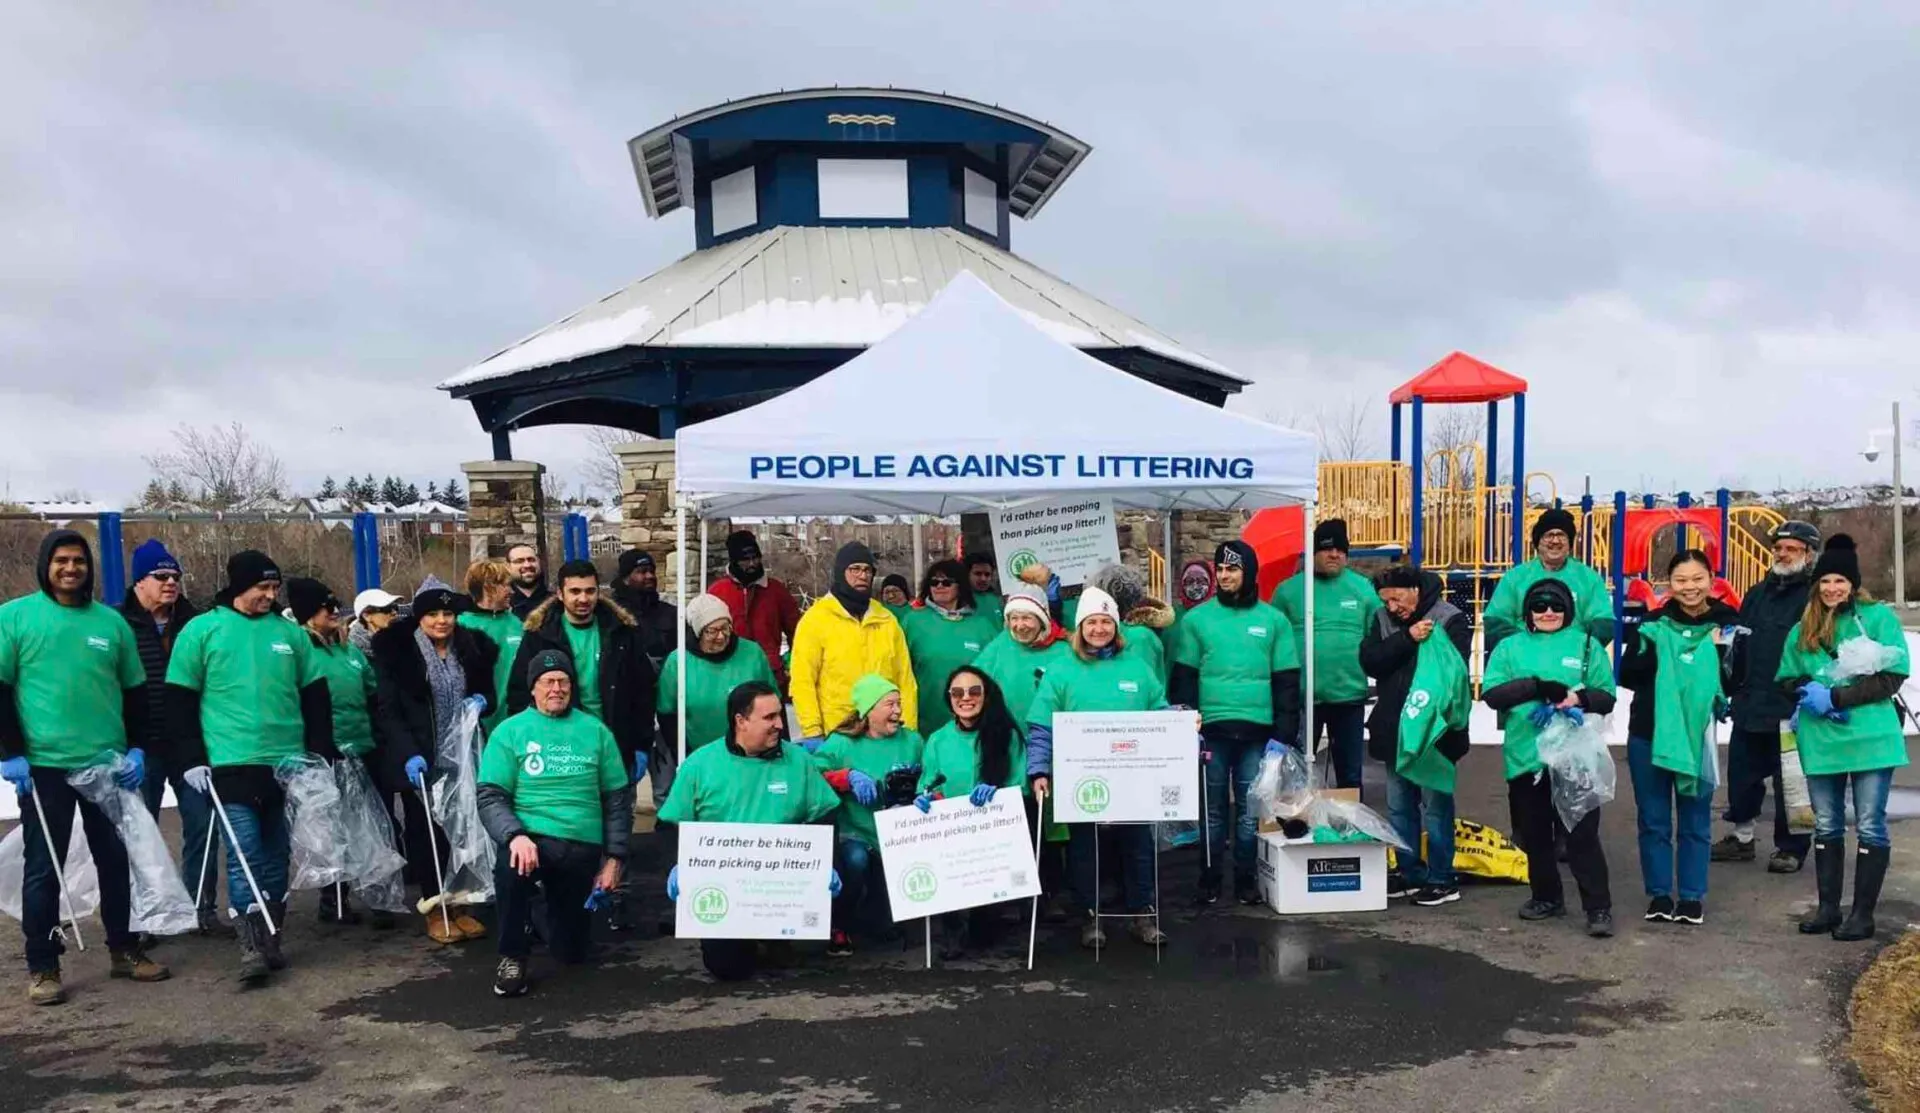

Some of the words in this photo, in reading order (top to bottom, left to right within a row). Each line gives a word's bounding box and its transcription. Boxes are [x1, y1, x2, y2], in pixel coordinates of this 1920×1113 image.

[750, 454, 896, 480] PEOPLE
[907, 454, 1065, 479] AGAINST
[1078, 455, 1254, 480] LITTERING
[1001, 513, 1013, 524] I'd
[1015, 508, 1045, 521] rather
[1047, 506, 1059, 517] be
[1061, 501, 1101, 515] napping
[1000, 528, 1022, 540] than
[1024, 525, 1059, 539] picking
[1061, 521, 1073, 531] up
[1075, 516, 1106, 529] litter!!
[547, 743, 572, 752] Good
[895, 819, 907, 830] I'd
[909, 815, 938, 827] rather
[940, 811, 952, 822] be
[953, 805, 989, 819] playing
[990, 803, 1005, 814] my
[884, 835, 918, 848] ukulele
[920, 831, 942, 842] than
[944, 825, 977, 838] picking
[979, 822, 991, 832] up
[993, 815, 1022, 828] litter!!
[699, 836, 714, 847] I'd
[717, 836, 755, 848] rather
[757, 837, 773, 848] be
[775, 837, 811, 851] hiking
[688, 857, 716, 868] than
[719, 857, 762, 871] picking
[765, 860, 780, 871] up
[783, 858, 821, 870] litter!!
